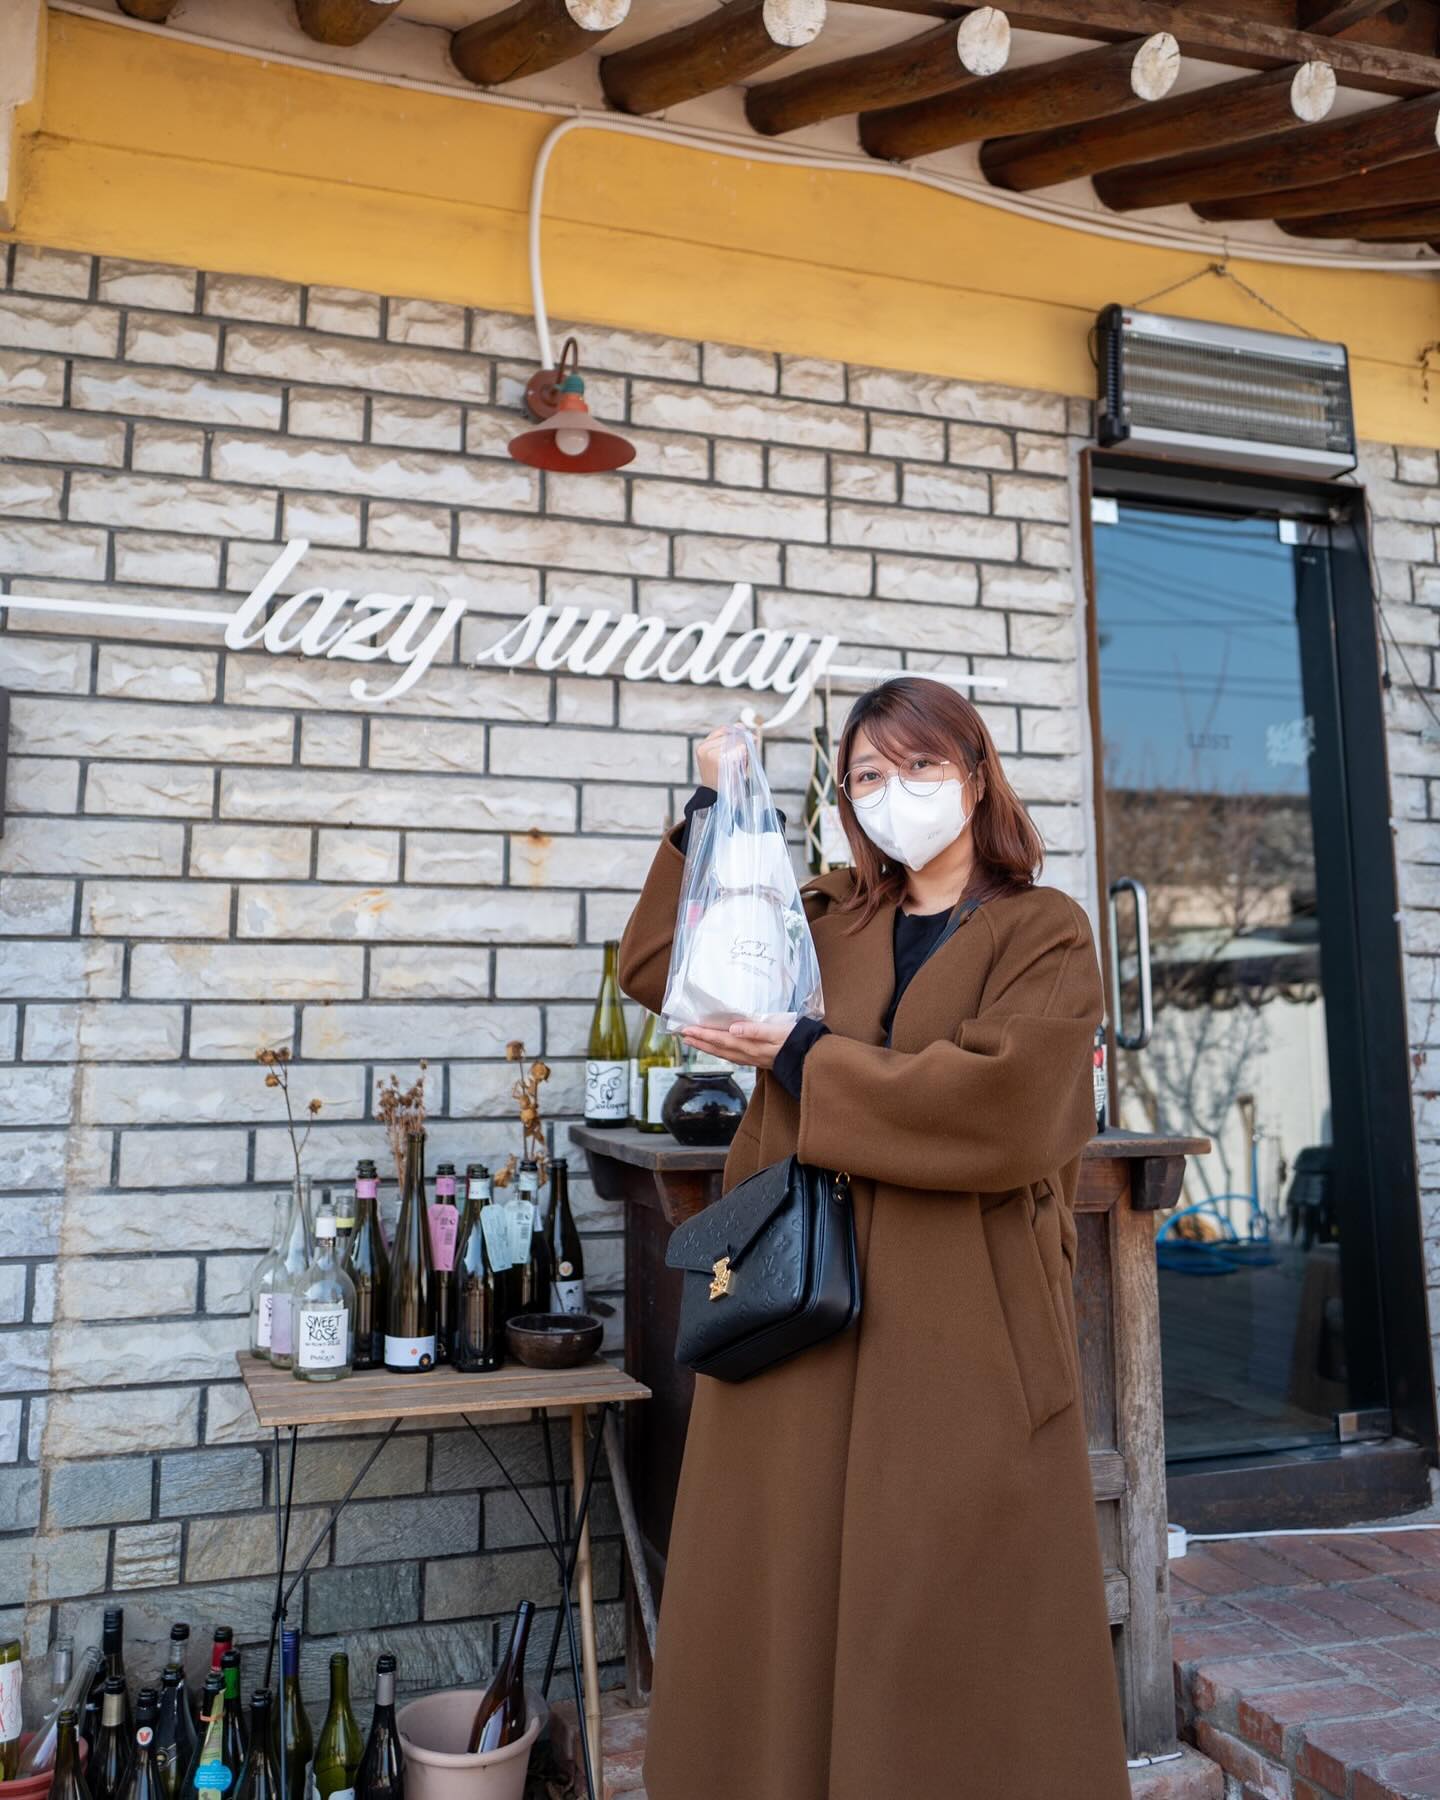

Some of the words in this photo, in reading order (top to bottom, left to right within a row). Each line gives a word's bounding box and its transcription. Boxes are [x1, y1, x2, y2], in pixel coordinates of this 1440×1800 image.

[225, 538, 467, 700] lazy
[477, 583, 839, 728] sunday
[306, 1315, 342, 1328] SWEET
